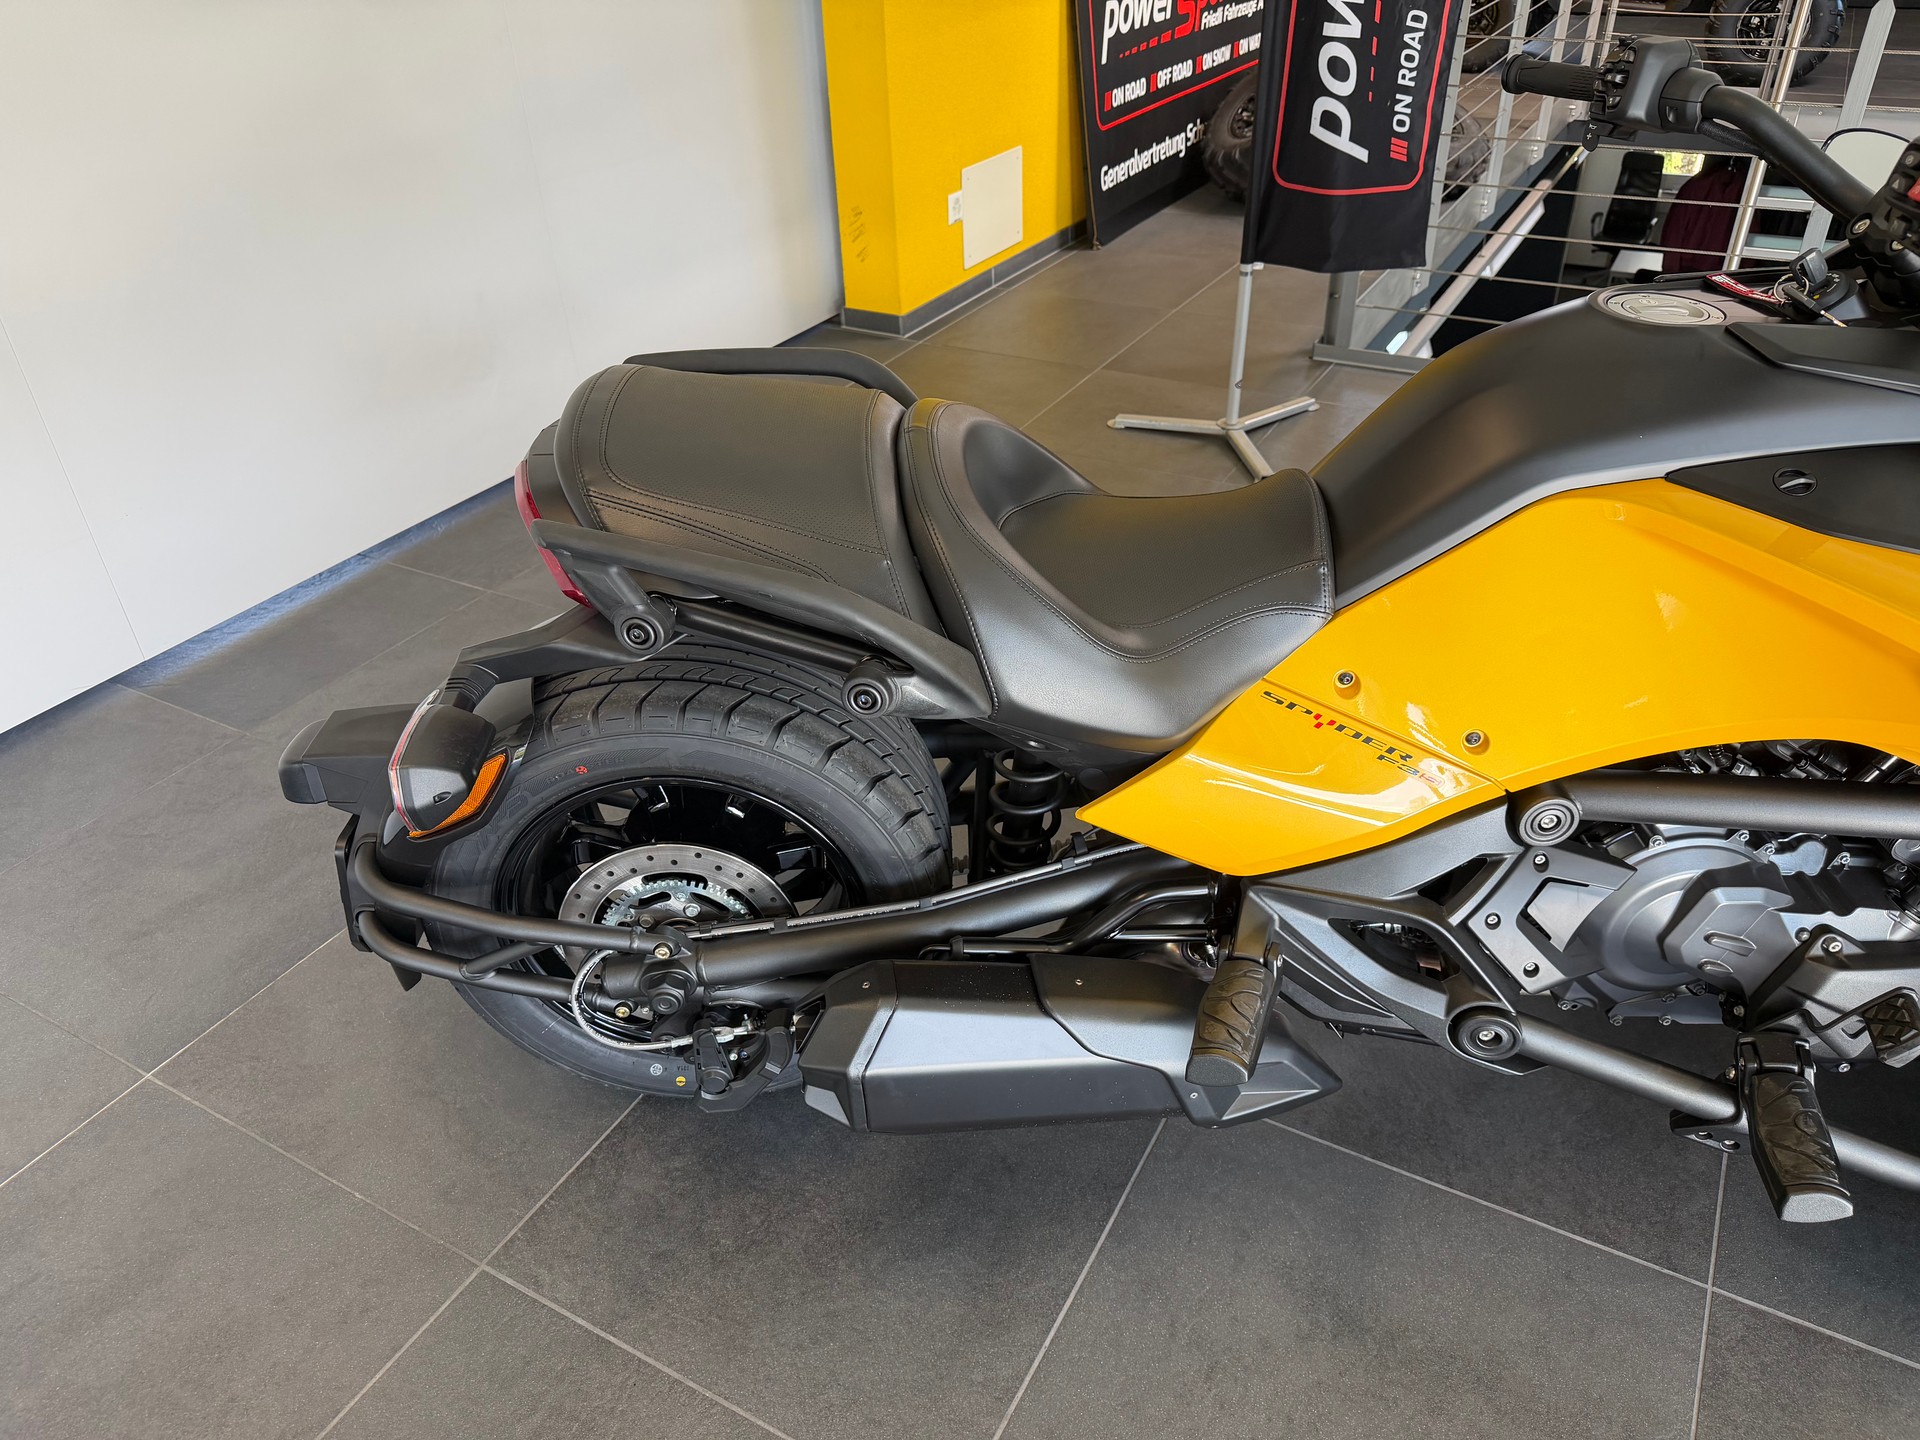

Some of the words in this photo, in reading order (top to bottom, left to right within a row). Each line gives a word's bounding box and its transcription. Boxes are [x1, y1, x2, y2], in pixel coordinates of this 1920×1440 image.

[1202, 51, 1213, 72] ON
[1213, 43, 1232, 67] SNOW
[1397, 9, 1428, 88] ROAD
[1112, 88, 1125, 108] ON
[1125, 77, 1147, 103] ROAD
[1157, 67, 1172, 89] OFF
[1172, 59, 1193, 84] ROAD
[1392, 93, 1413, 133] ON
[1100, 131, 1186, 192] Generalvertretung
[1260, 690, 1413, 762] SPYDER
